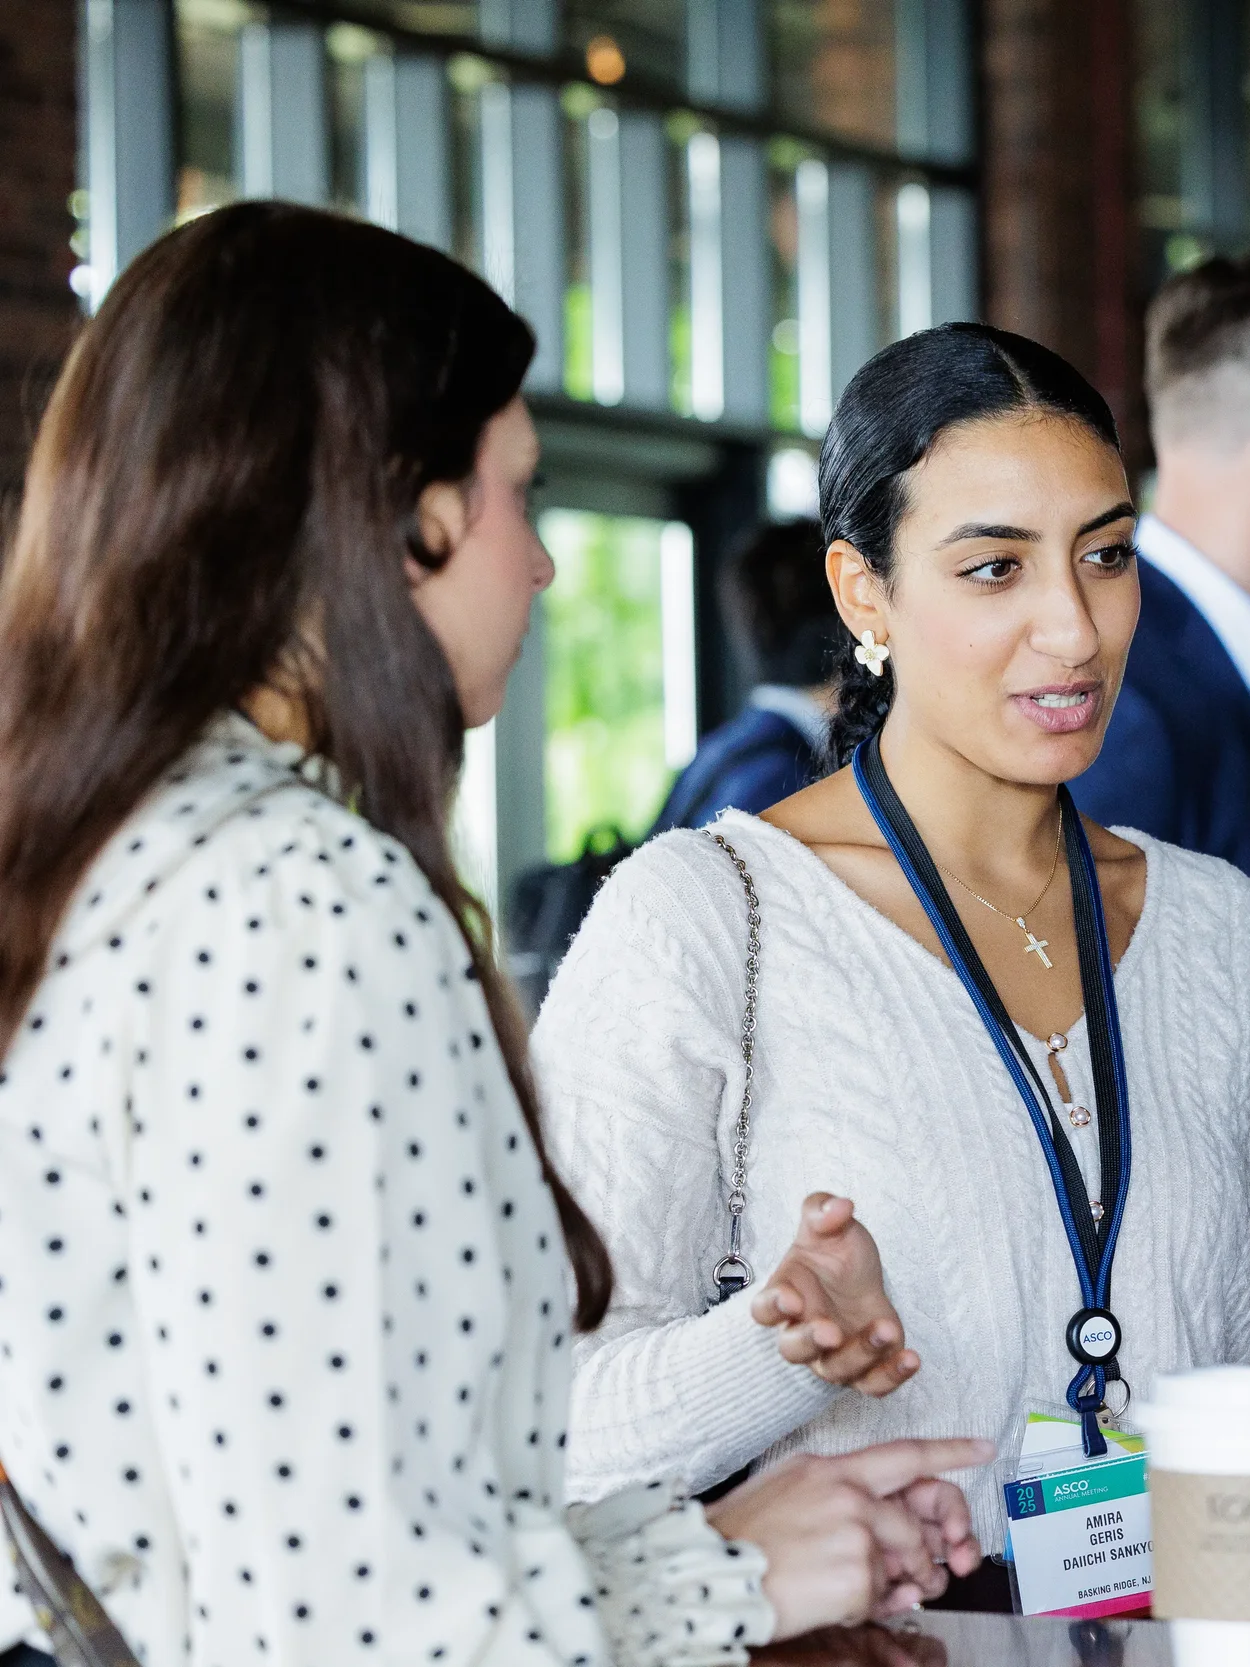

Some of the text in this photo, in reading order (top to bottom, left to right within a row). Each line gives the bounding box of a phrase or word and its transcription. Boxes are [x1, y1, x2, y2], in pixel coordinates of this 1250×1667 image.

[1083, 1331, 1112, 1343] ASCO
[1016, 1487, 1034, 1501] 20
[1053, 1480, 1089, 1497] ASCO
[1054, 1486, 1109, 1503] ANNUAL MEETING
[1018, 1500, 1036, 1514] 25
[1086, 1511, 1124, 1530] AMIRA
[1089, 1528, 1124, 1546] GERIS
[1063, 1551, 1106, 1571] DAIICHI
[1078, 1576, 1152, 1599] BASKING RIDGE, NJ
